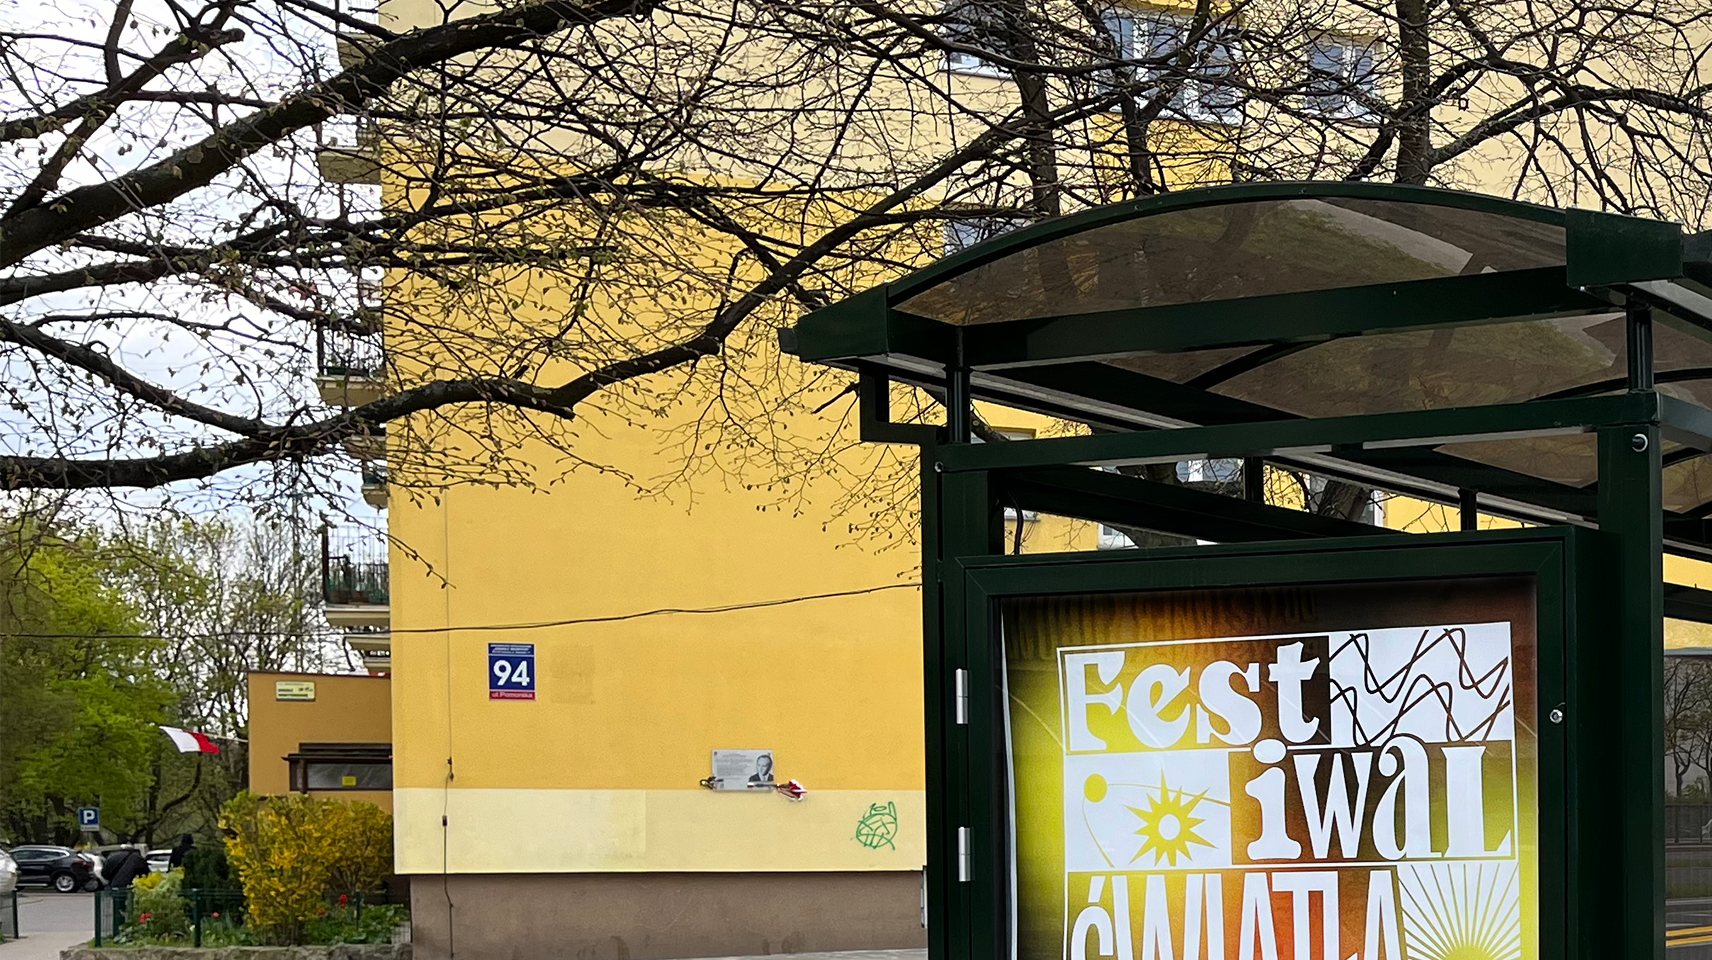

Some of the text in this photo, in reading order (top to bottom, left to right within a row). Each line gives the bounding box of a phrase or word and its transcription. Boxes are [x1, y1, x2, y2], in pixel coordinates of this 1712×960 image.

[494, 660, 530, 686] 94
[1064, 640, 1321, 752] Fest
[83, 810, 95, 823] P
